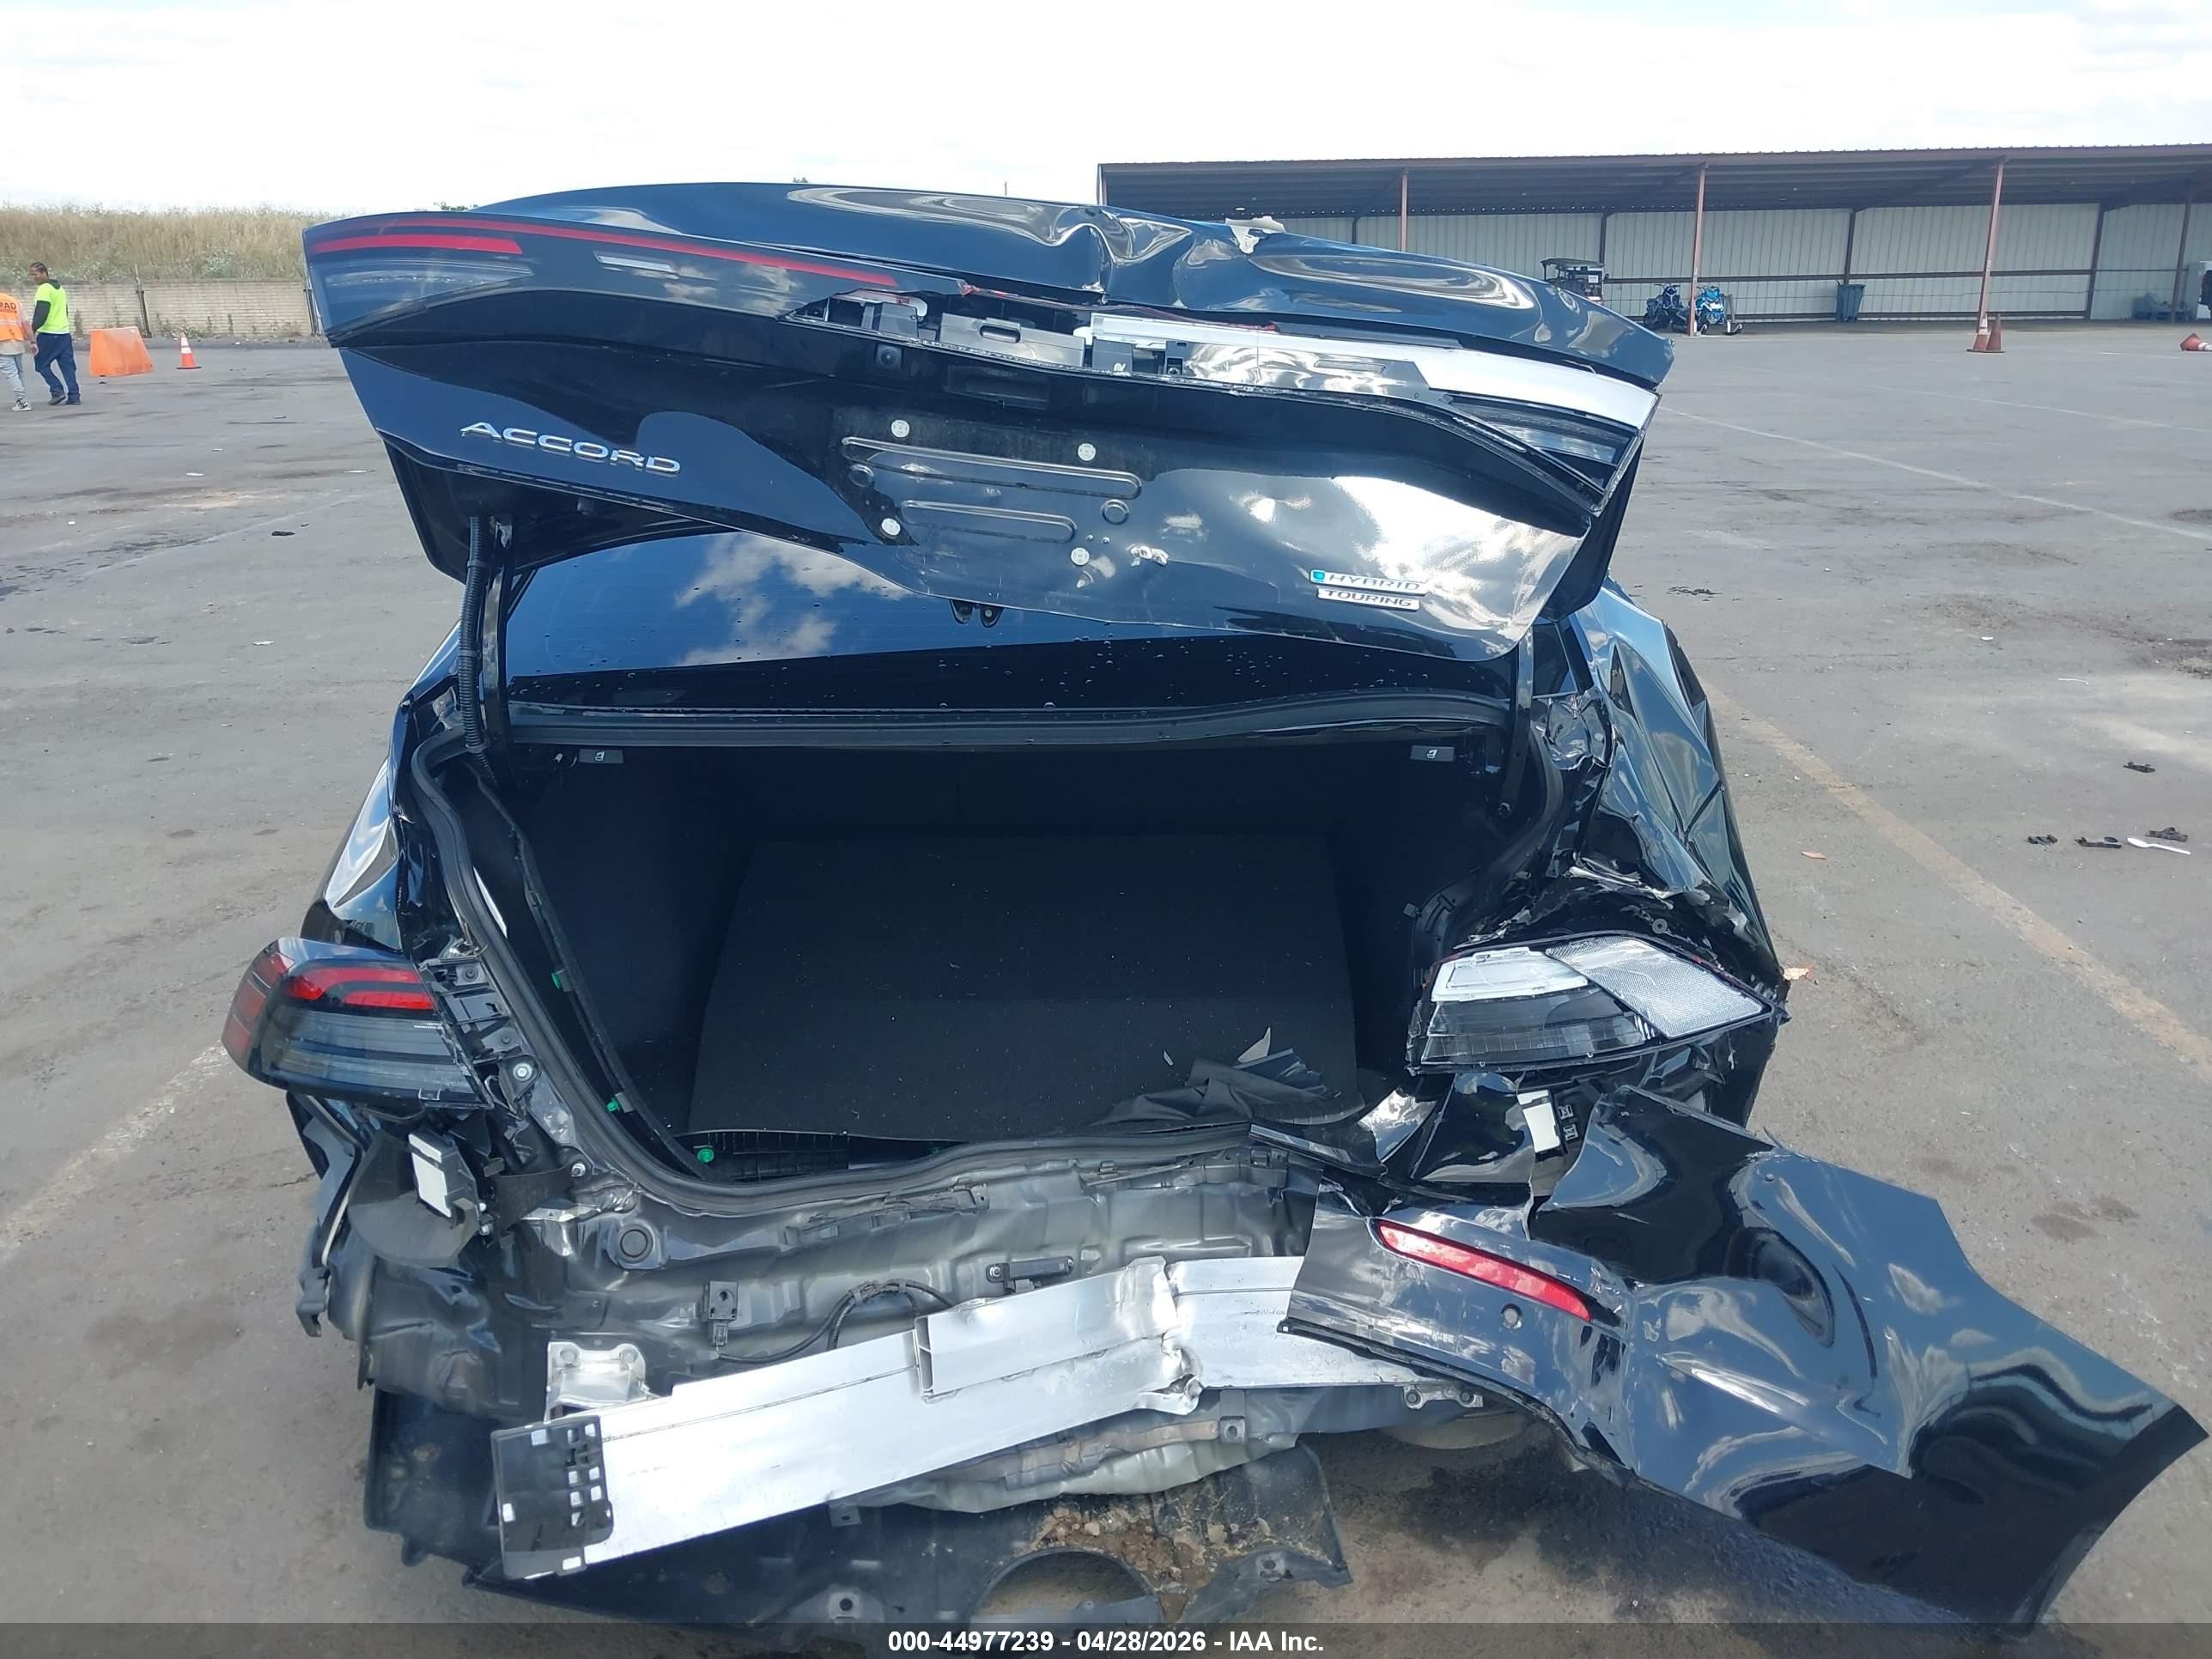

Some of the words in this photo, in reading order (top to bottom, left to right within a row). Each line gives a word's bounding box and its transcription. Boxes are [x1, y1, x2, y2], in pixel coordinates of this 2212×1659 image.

[460, 422, 681, 474] ACCORD
[1329, 574, 1420, 591] HYBRID
[1324, 590, 1412, 607] TOURING
